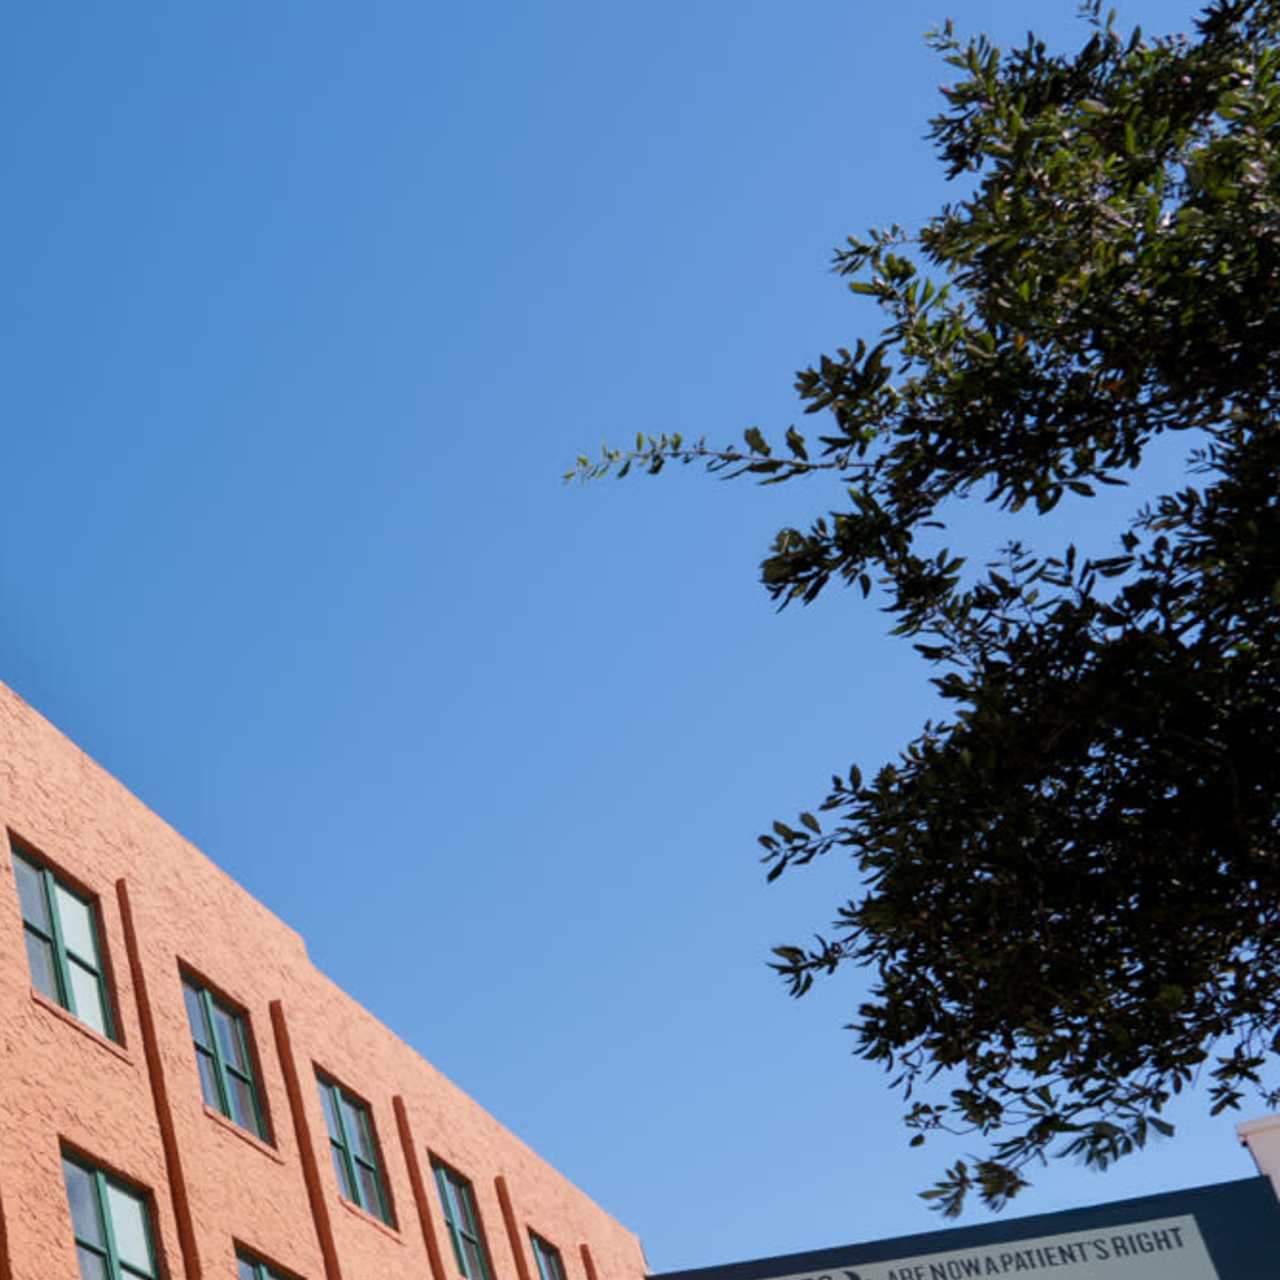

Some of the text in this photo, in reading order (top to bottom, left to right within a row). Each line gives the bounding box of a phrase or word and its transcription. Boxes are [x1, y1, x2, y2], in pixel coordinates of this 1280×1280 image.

[985, 1254, 1000, 1275] A
[999, 1239, 1111, 1273] PATIENT'S
[1115, 1227, 1188, 1259] RIGHT
